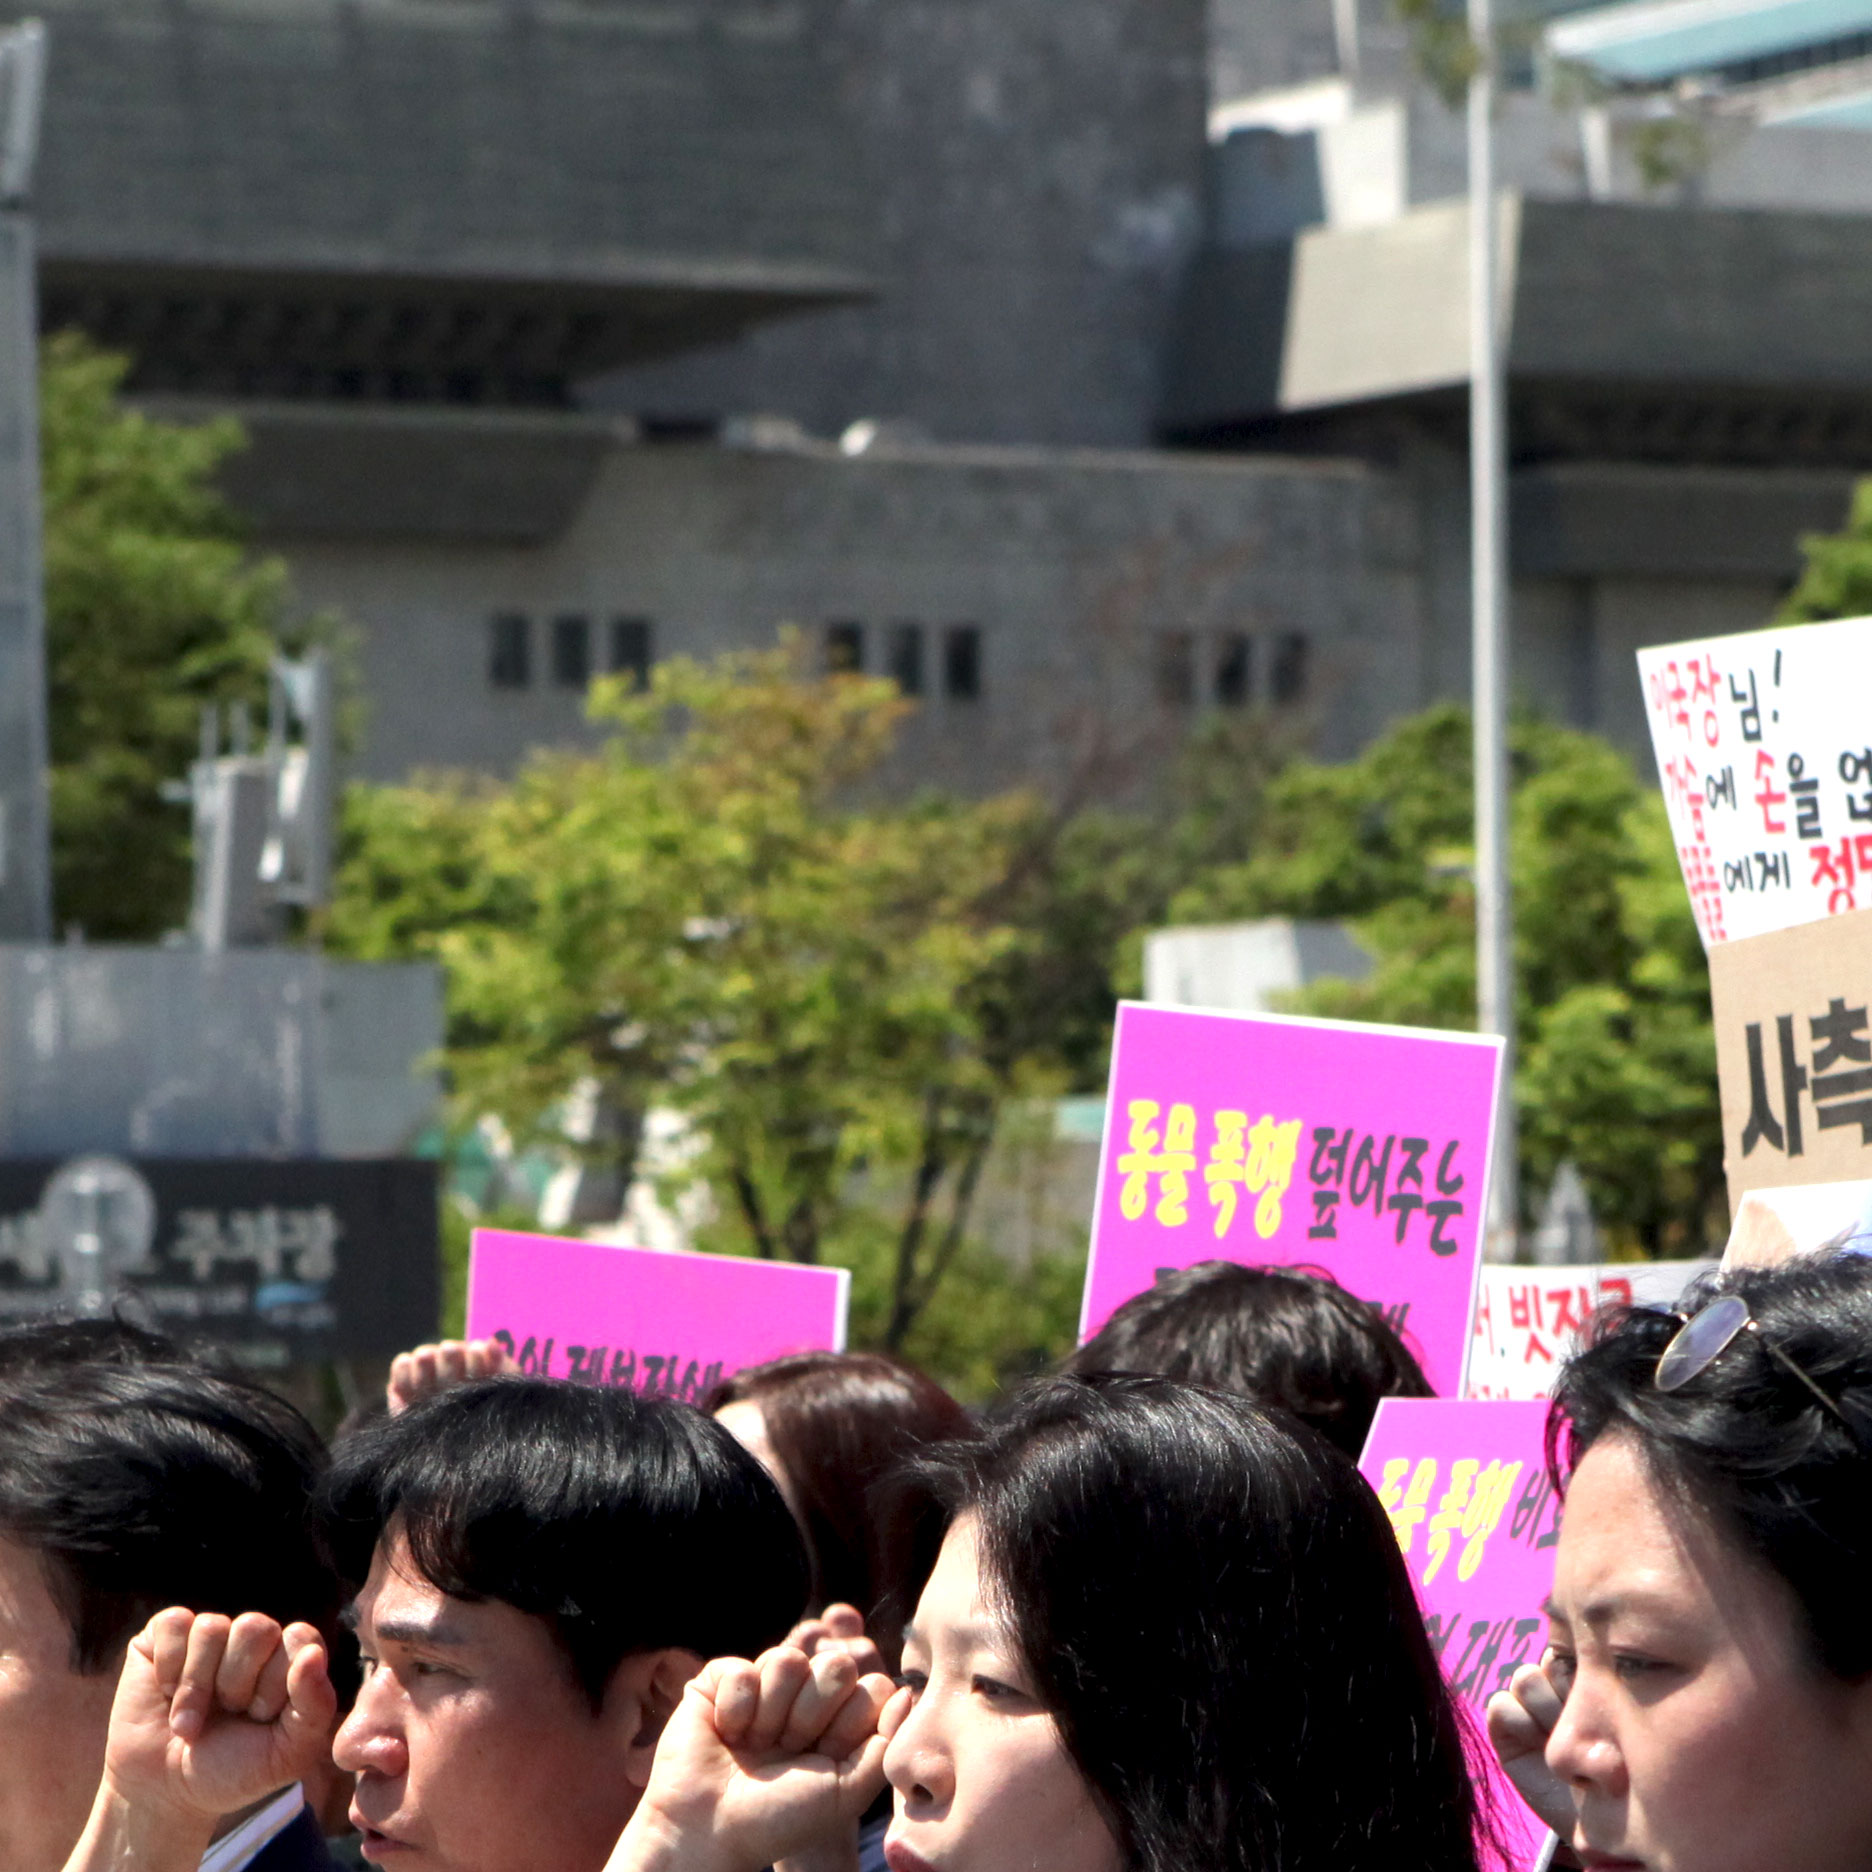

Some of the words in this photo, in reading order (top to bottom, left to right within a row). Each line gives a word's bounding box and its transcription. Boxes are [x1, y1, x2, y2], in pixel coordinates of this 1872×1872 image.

[1754, 749, 1822, 839] 손을
[1116, 1098, 1197, 1228] 동물
[1204, 1108, 1304, 1240] 폭행
[1308, 1126, 1465, 1257] 덮어주는
[1429, 1458, 1524, 1587] 폭행
